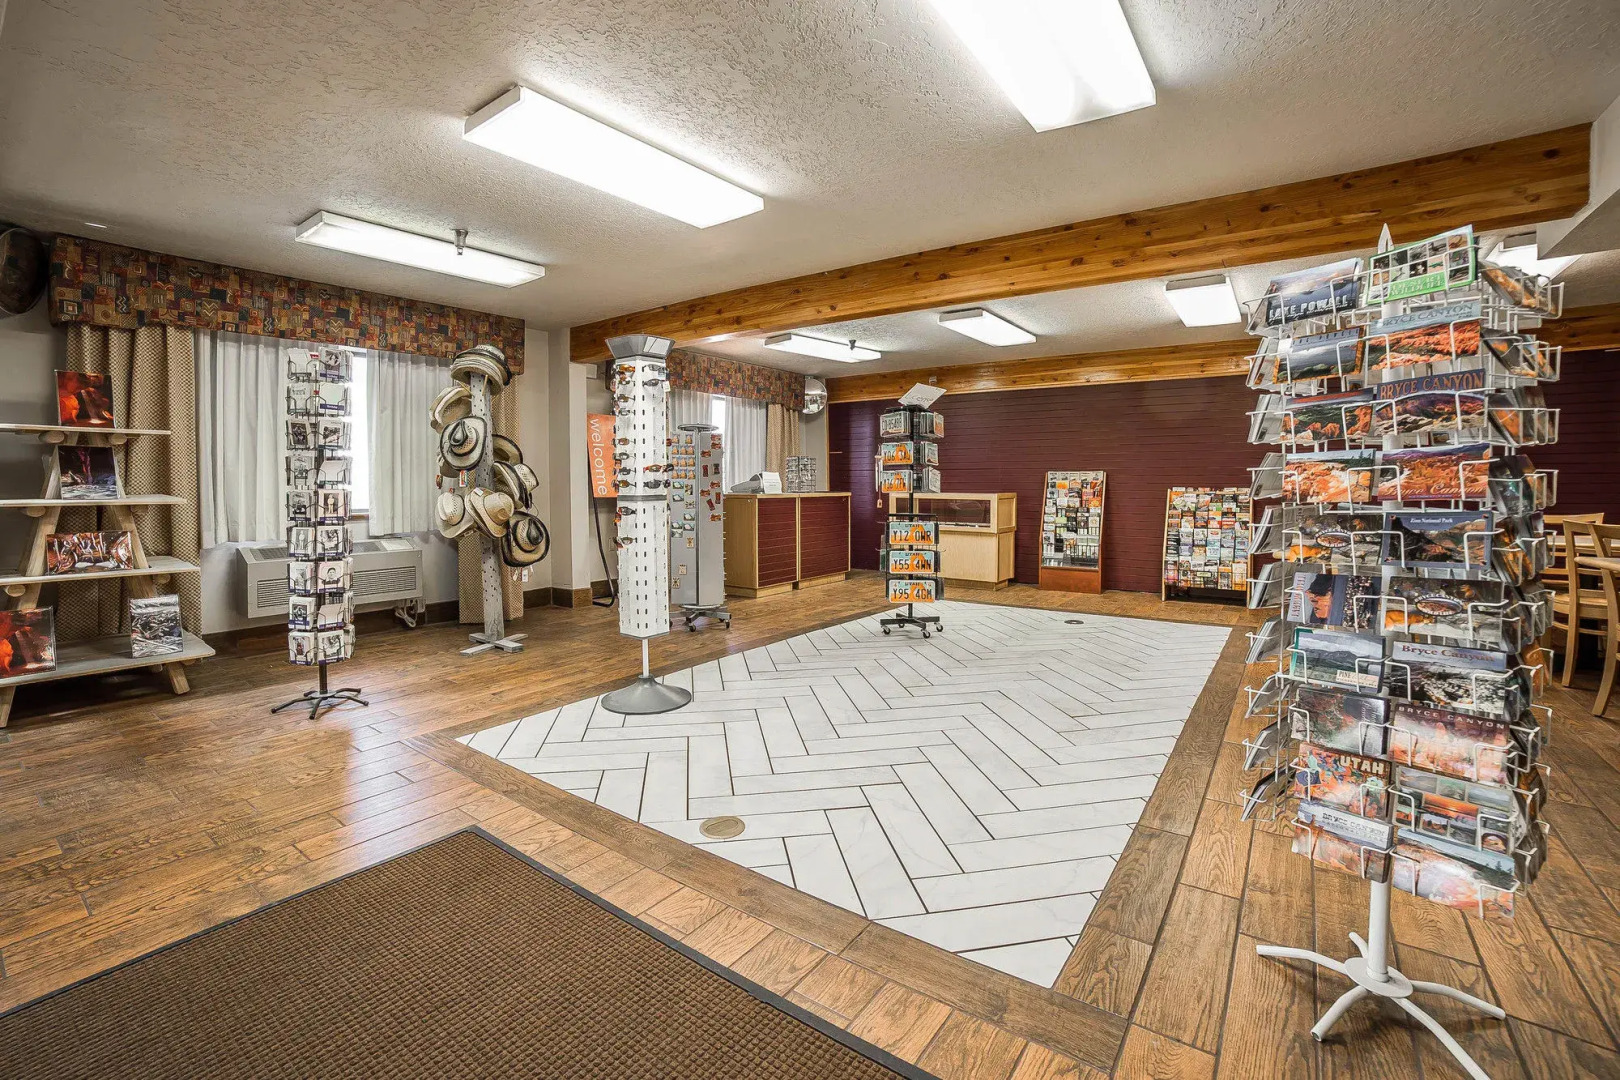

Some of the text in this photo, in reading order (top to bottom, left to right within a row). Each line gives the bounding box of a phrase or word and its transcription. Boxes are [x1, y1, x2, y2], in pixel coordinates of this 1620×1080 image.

[1380, 371, 1485, 400] BRYCE CANYON
[589, 418, 607, 495] welcome
[893, 531, 909, 541] Y12
[893, 559, 909, 570] Y55
[893, 588, 909, 599] Y95
[1402, 645, 1496, 662] Bryce Canyon
[1398, 706, 1439, 718] BRYCE
[1447, 714, 1505, 730] CANYON
[1339, 755, 1385, 775] UTAH
